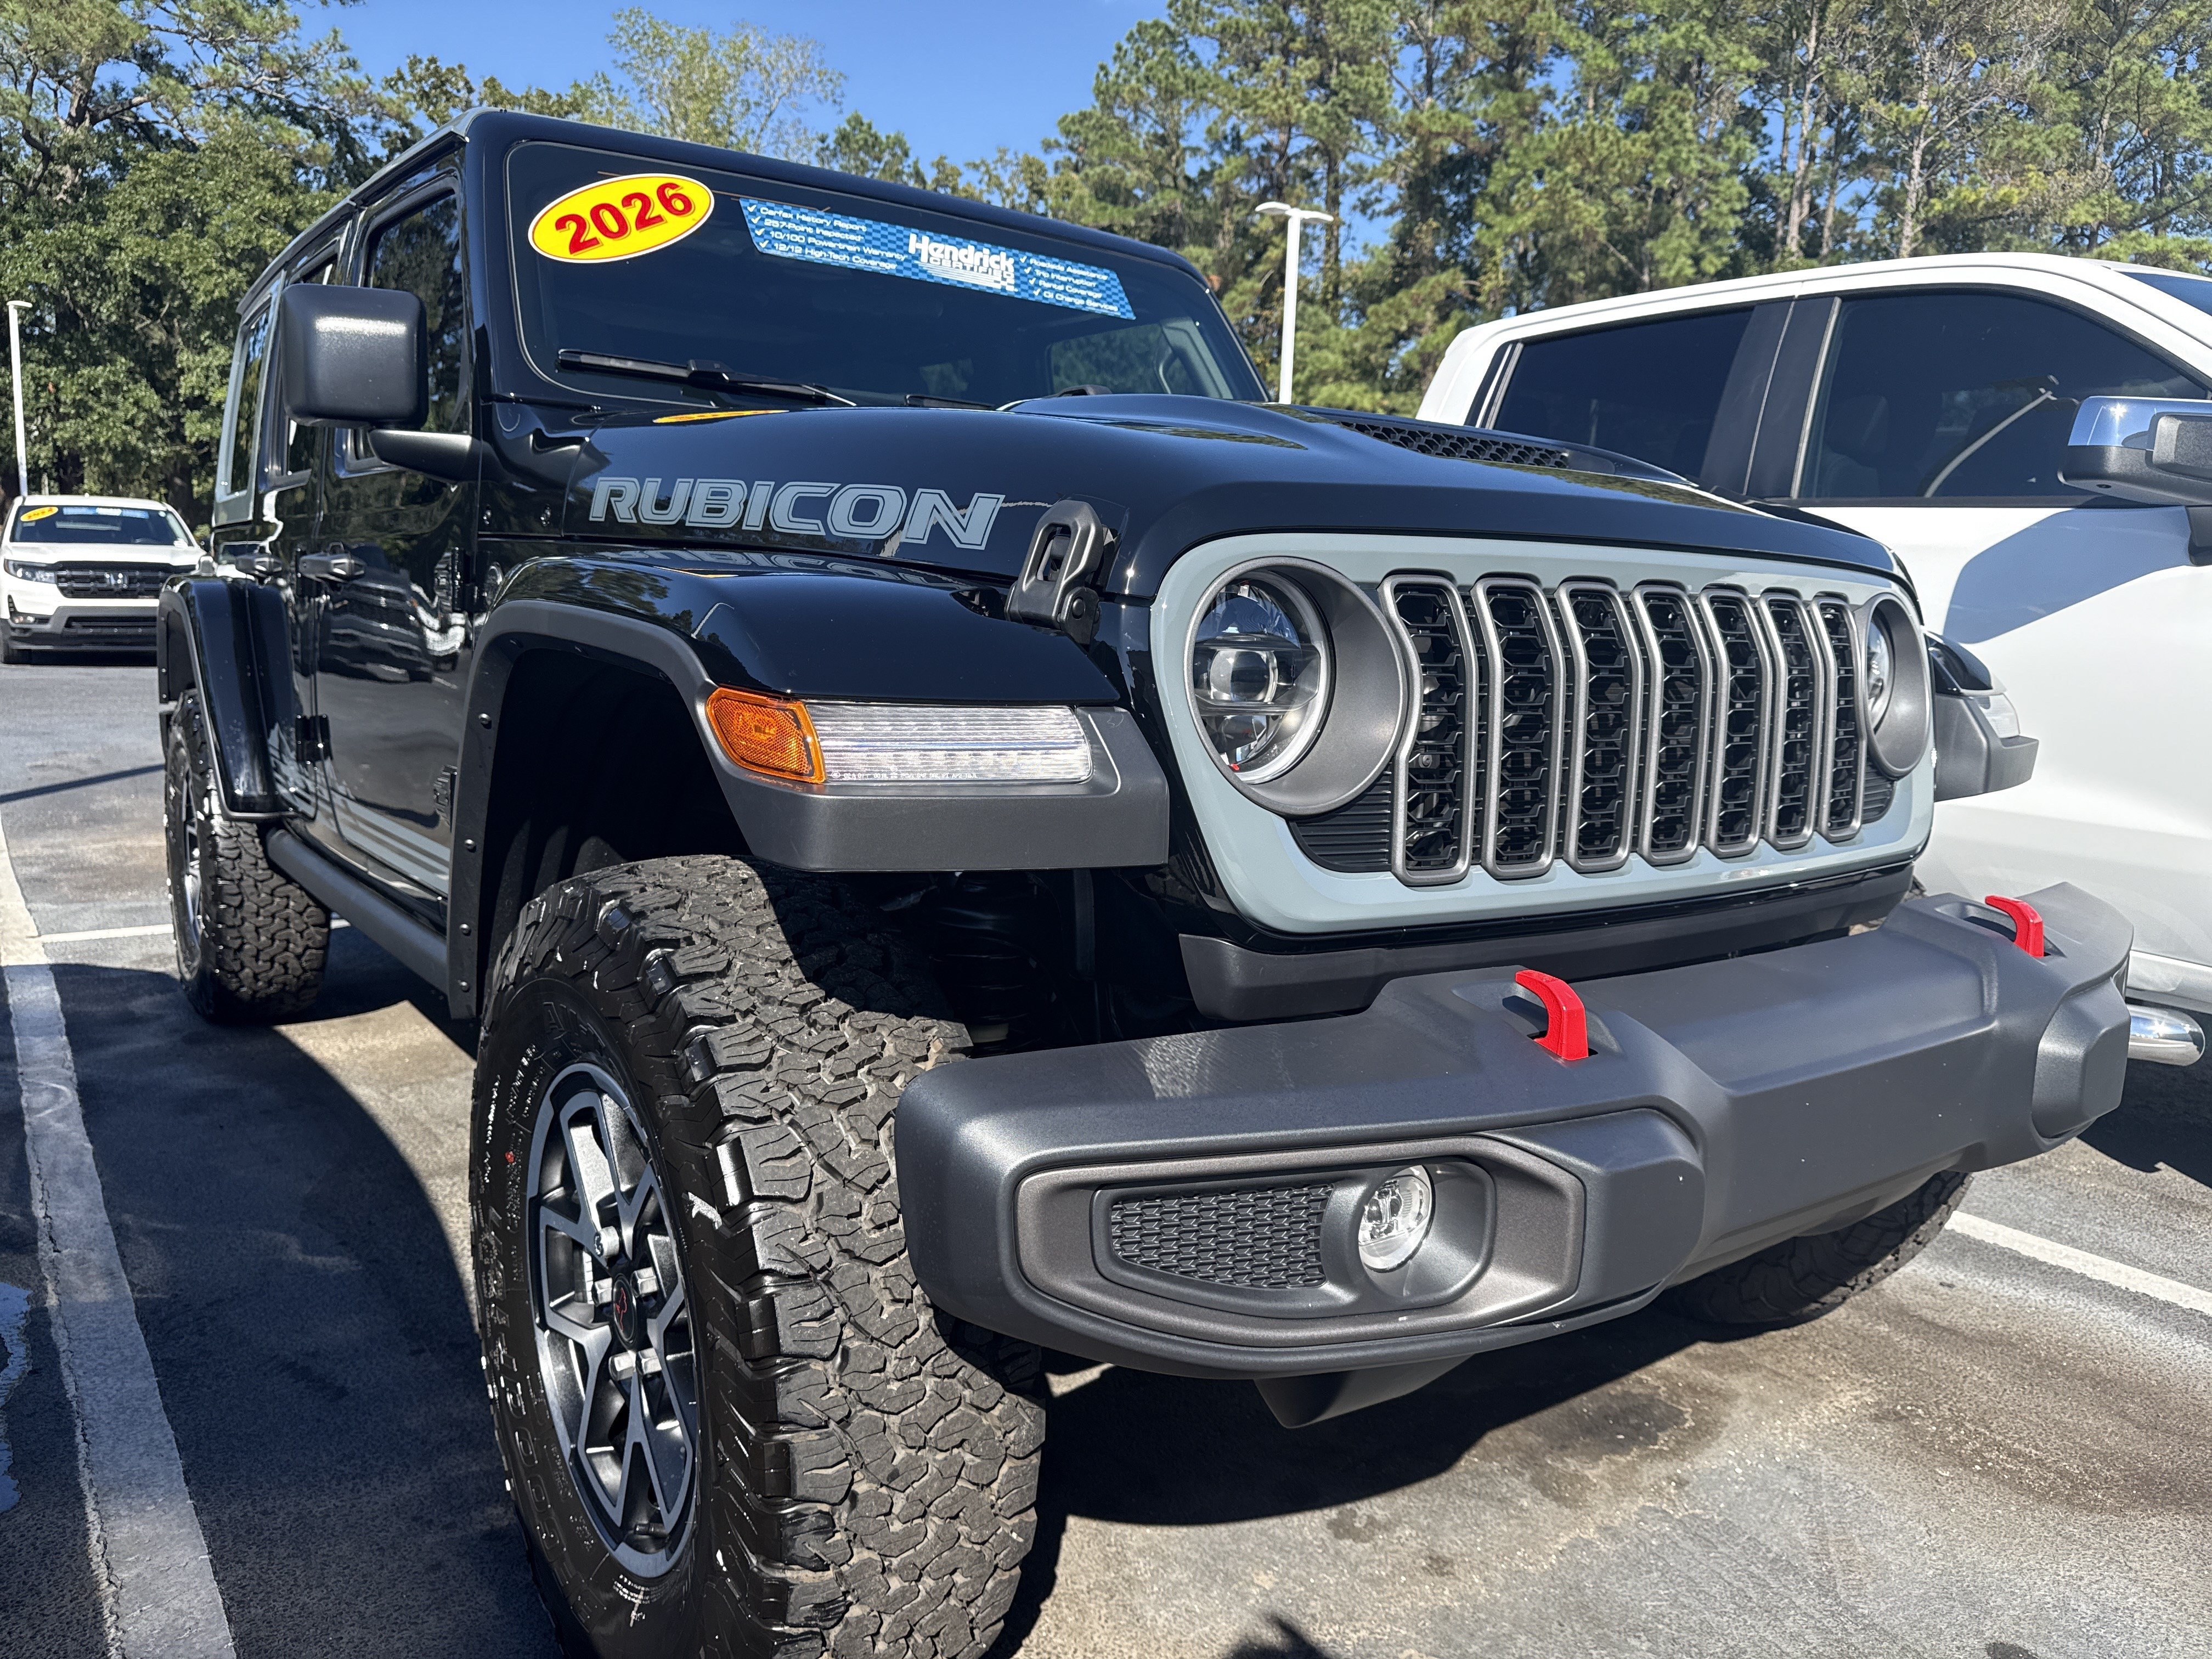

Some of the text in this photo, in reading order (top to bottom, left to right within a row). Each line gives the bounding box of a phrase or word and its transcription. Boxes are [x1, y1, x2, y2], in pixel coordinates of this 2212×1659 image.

[554, 182, 695, 256] 2026
[760, 207, 867, 232] Carfax History Report
[764, 218, 814, 234] 257-Point
[769, 230, 907, 261] 10/100 Powertrain Warranty
[774, 242, 898, 270] 12/12 High-Tech Coverage
[908, 233, 1015, 273] Hendrick
[929, 256, 1015, 280] CERTIFIED
[1029, 257, 1065, 272] Roadside
[1034, 268, 1097, 288] Trip Interruption
[1039, 279, 1103, 299] Rental Coverage
[1055, 292, 1085, 306] Change
[1086, 298, 1119, 312] Services
[589, 476, 1006, 551] RUBICON
